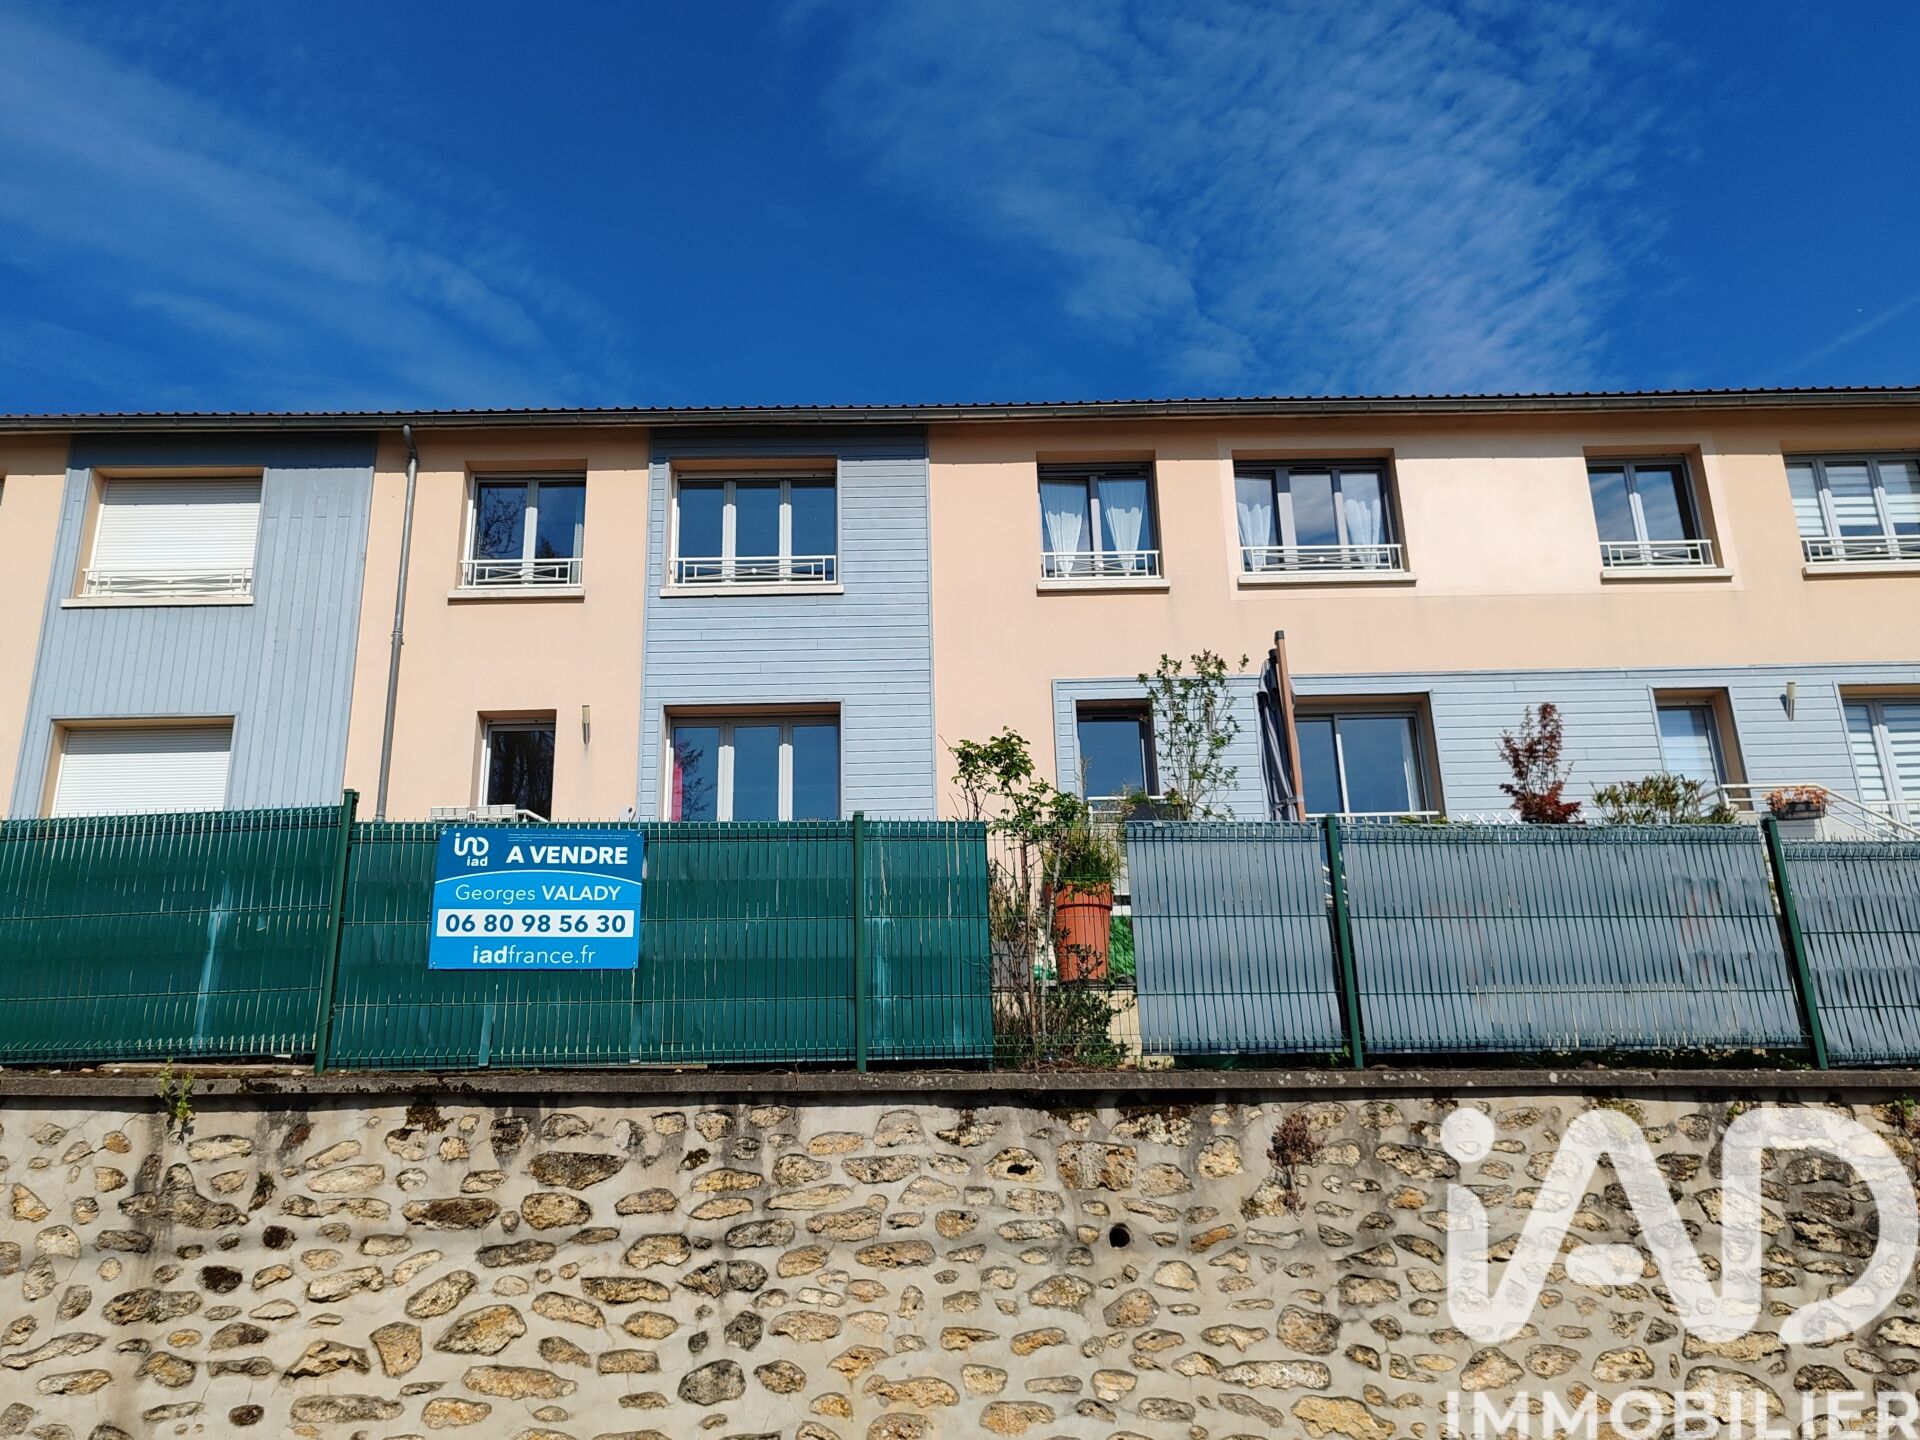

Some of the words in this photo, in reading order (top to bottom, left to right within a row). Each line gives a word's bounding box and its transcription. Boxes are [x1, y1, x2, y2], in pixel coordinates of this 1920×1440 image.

[466, 856, 488, 867] iad
[505, 846, 524, 864] A
[529, 846, 628, 865] VENDRE
[455, 884, 536, 905] Georges
[541, 885, 621, 901] VALADY
[445, 914, 476, 933] 06
[483, 914, 514, 933] 80
[521, 914, 551, 933] 98
[558, 914, 589, 933] 56
[595, 914, 626, 933] 30
[472, 945, 596, 964] iadfrance.fr
